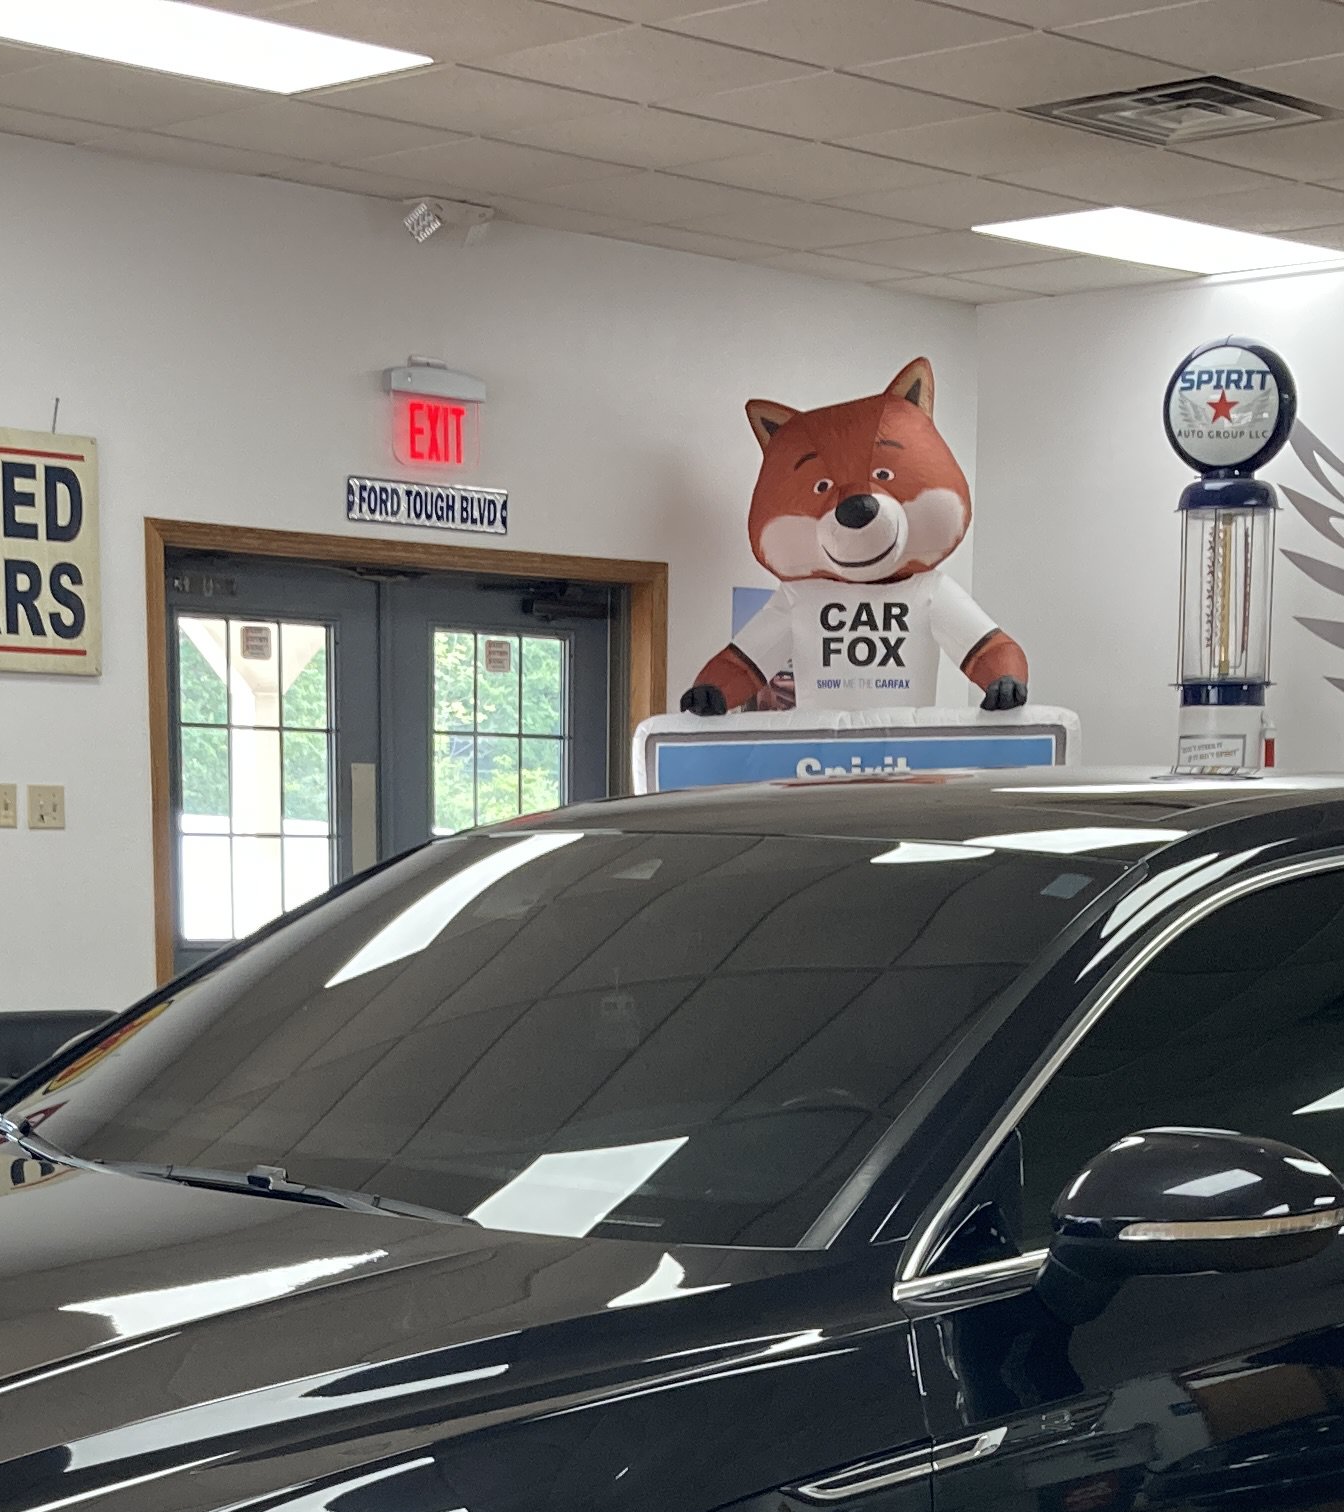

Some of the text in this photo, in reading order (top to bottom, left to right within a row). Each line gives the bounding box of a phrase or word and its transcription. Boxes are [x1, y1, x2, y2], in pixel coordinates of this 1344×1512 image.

[1178, 369, 1272, 391] SPIRIT
[409, 402, 465, 464] EXIT
[1178, 430, 1269, 439] AUTO GROUP LLC
[358, 484, 497, 526] FORD TOUGH BLVD
[819, 602, 910, 632] CAR
[822, 636, 906, 667] FOX
[817, 679, 841, 689] SHOW
[875, 679, 911, 689] CARFAX
